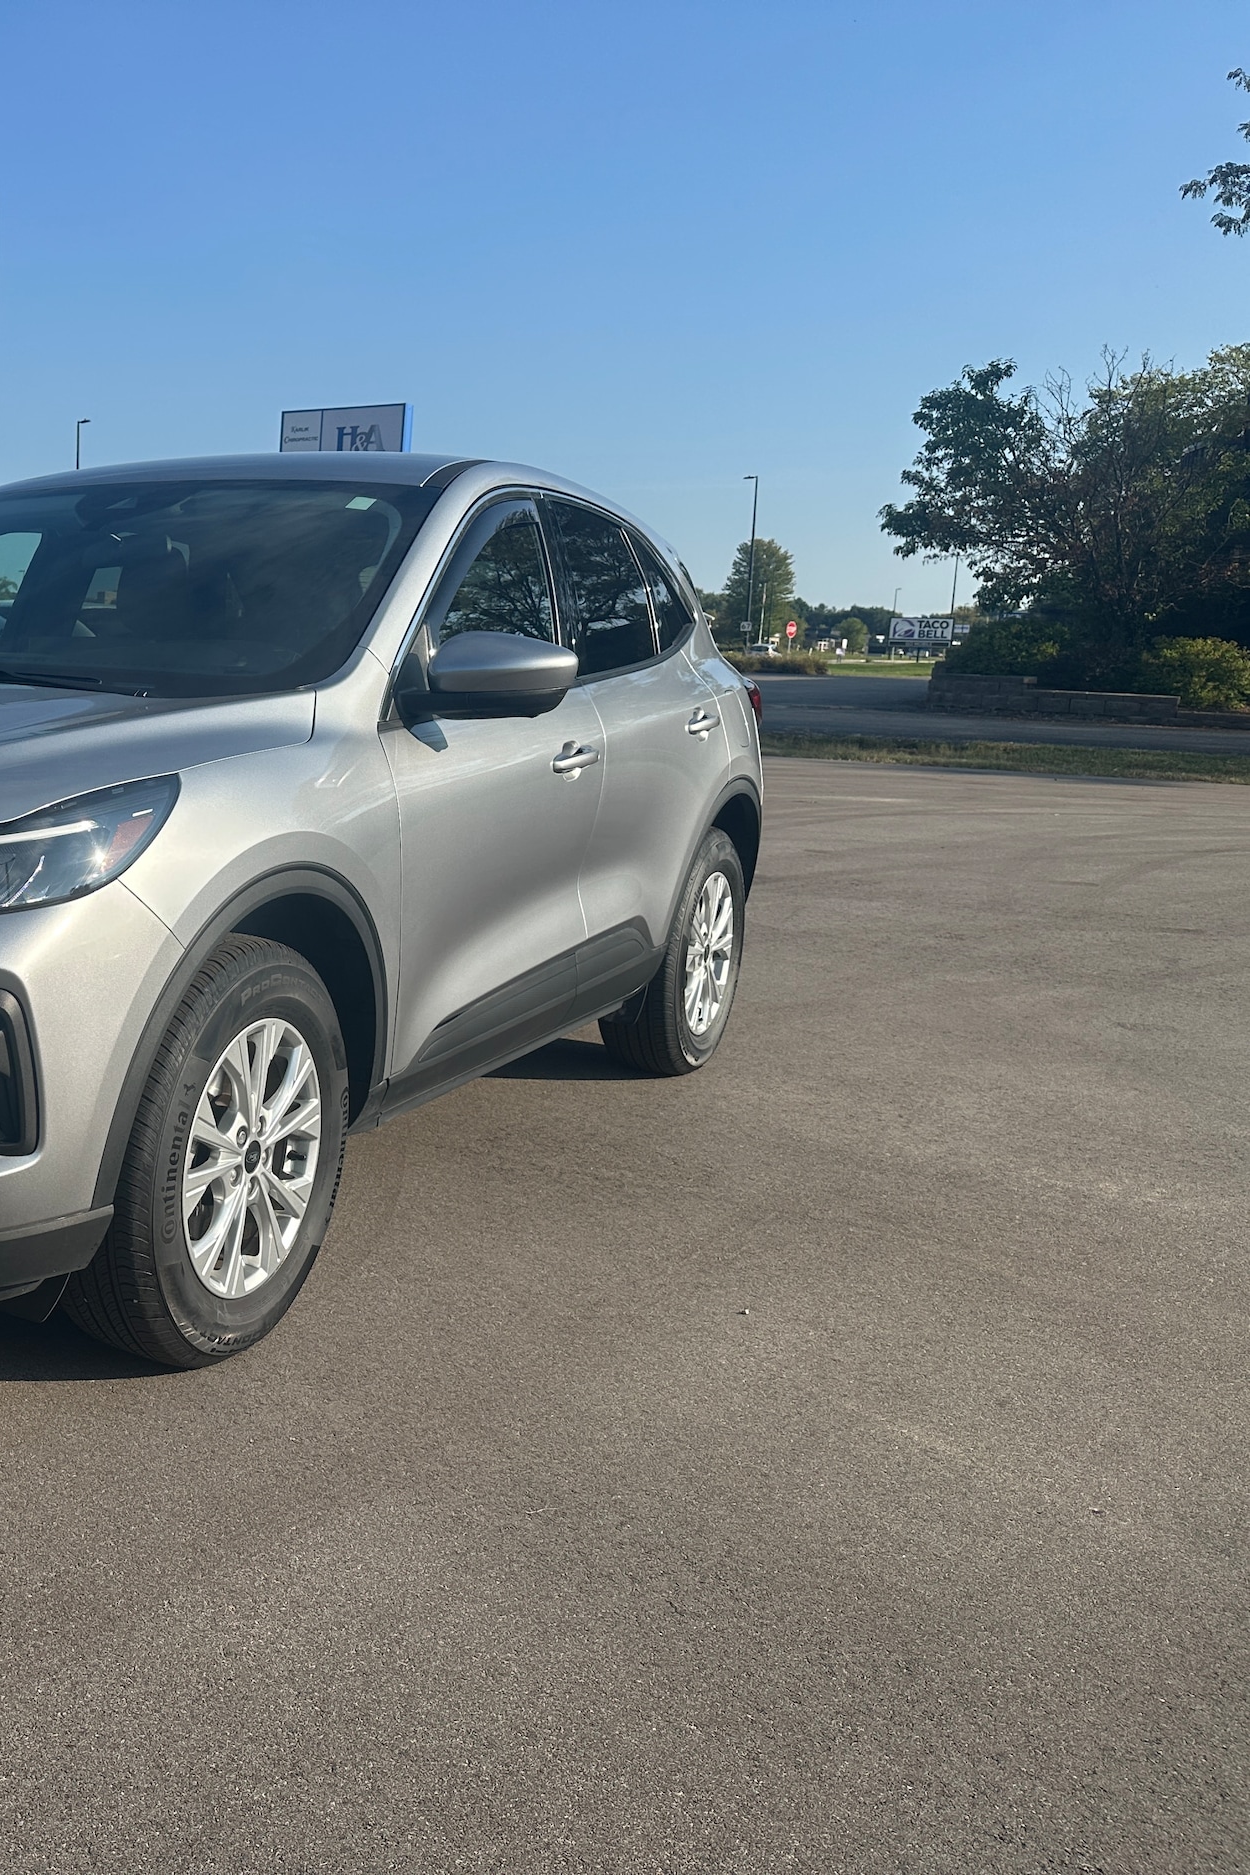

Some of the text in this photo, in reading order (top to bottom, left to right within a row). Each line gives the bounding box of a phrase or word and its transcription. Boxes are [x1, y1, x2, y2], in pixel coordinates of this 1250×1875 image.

[917, 620, 949, 629] TACO
[918, 630, 948, 638] BELL
[161, 1099, 191, 1245] Continental
